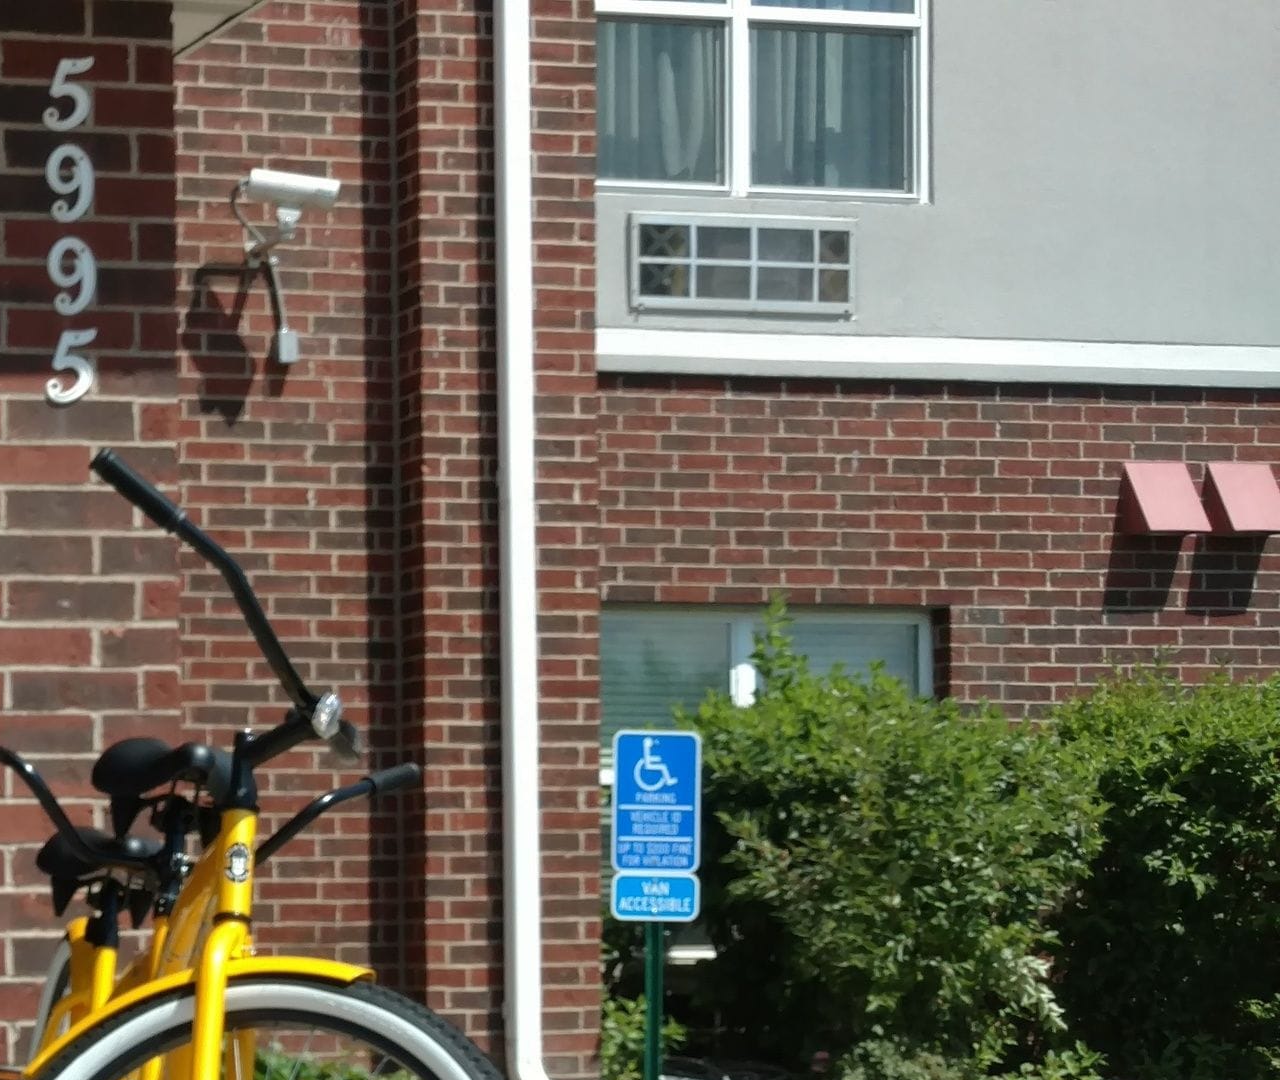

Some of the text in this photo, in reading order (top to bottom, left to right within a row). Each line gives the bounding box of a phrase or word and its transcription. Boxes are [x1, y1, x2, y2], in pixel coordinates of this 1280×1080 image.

[42, 56, 97, 404] 5995
[635, 792, 677, 804] PARKING
[630, 811, 669, 823] VEHICLE
[632, 823, 679, 835] REQUIRED
[641, 881, 671, 896] VAN
[619, 896, 691, 912] ACCESSIBLE
